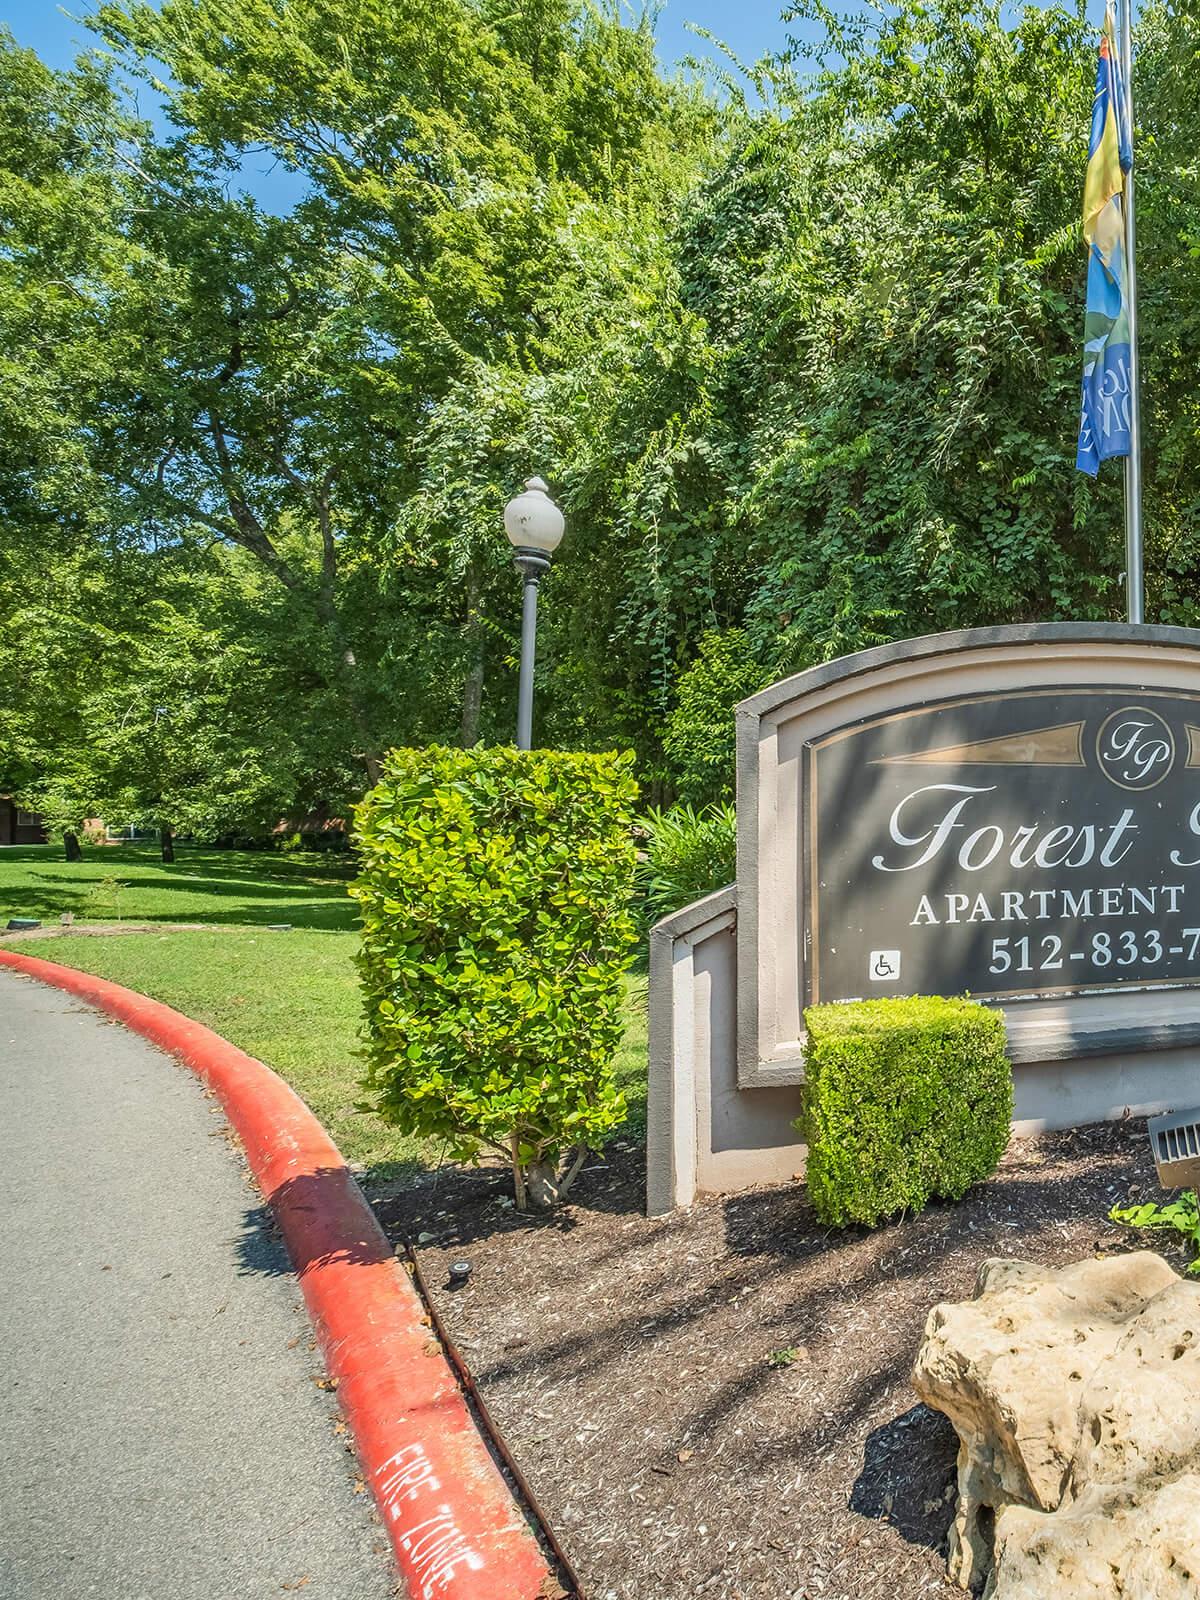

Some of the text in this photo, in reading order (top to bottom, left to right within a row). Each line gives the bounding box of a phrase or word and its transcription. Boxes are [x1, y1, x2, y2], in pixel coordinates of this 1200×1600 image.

[872, 783, 1139, 873] Forest
[909, 883, 1185, 926] APARTMENT
[375, 1442, 485, 1600] FIRE ZONE
